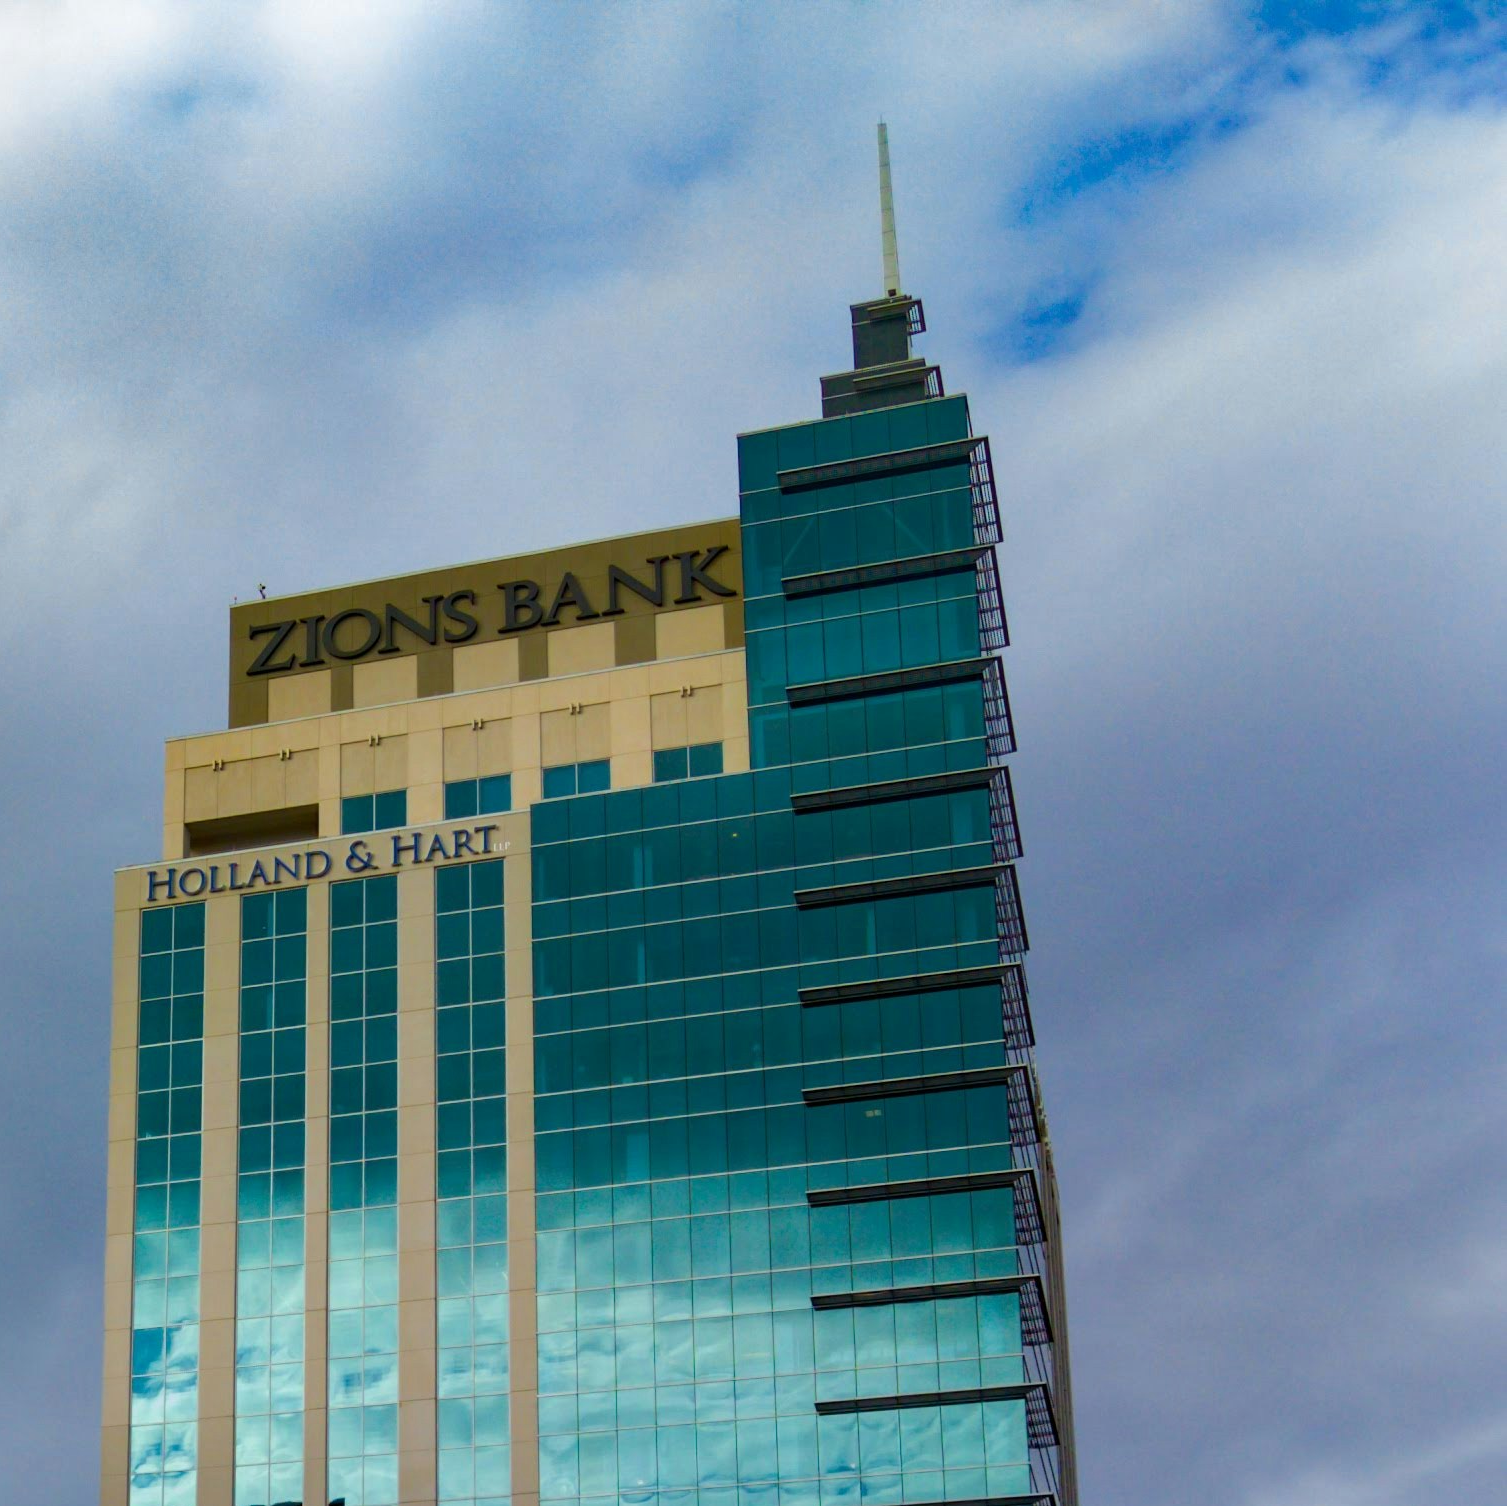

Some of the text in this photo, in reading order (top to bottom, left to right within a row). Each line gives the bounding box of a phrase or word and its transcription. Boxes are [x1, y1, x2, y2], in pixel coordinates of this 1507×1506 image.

[246, 545, 738, 677] ZIONS BANK
[147, 850, 332, 901] HOLLAND
[345, 840, 378, 873] &
[391, 825, 499, 867] HART
